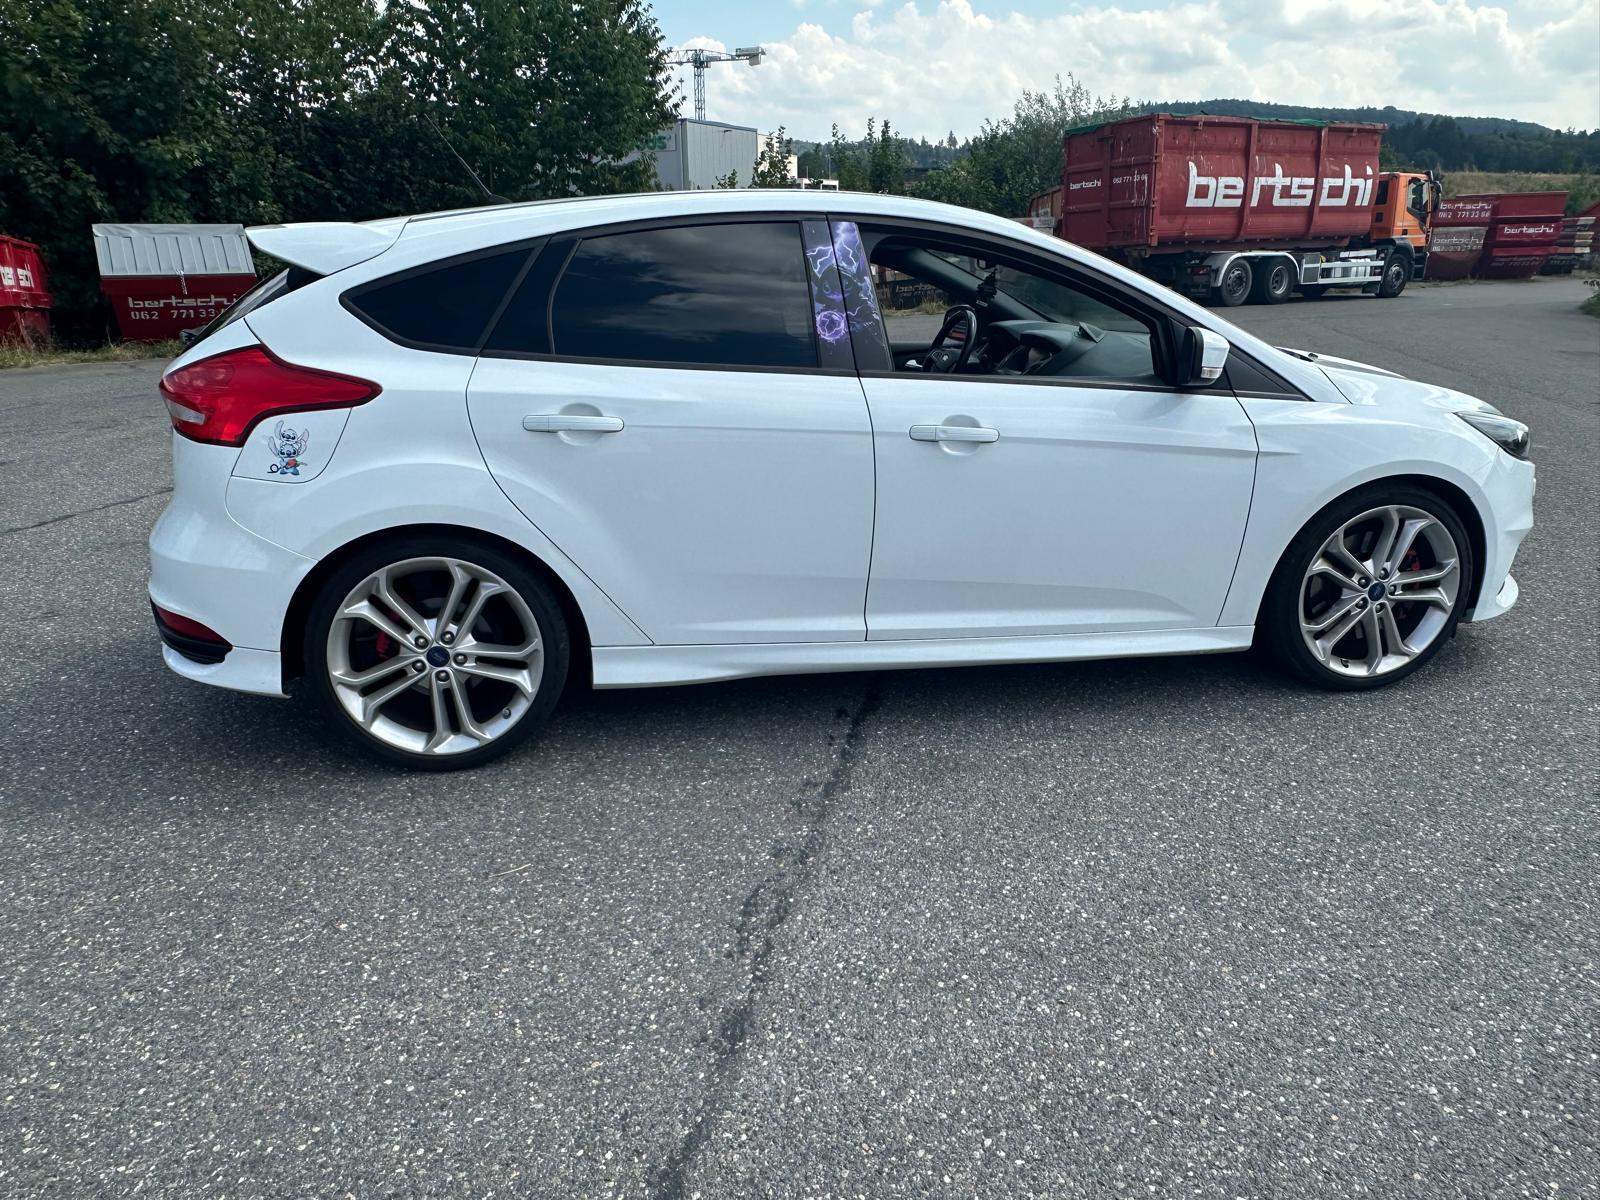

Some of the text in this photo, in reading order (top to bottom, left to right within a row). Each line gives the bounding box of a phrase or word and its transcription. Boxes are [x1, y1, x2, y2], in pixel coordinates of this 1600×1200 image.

[1070, 178, 1101, 190] bertschi
[1186, 161, 1373, 207] bertschi
[130, 311, 160, 320] 062
[170, 310, 195, 319] 771
